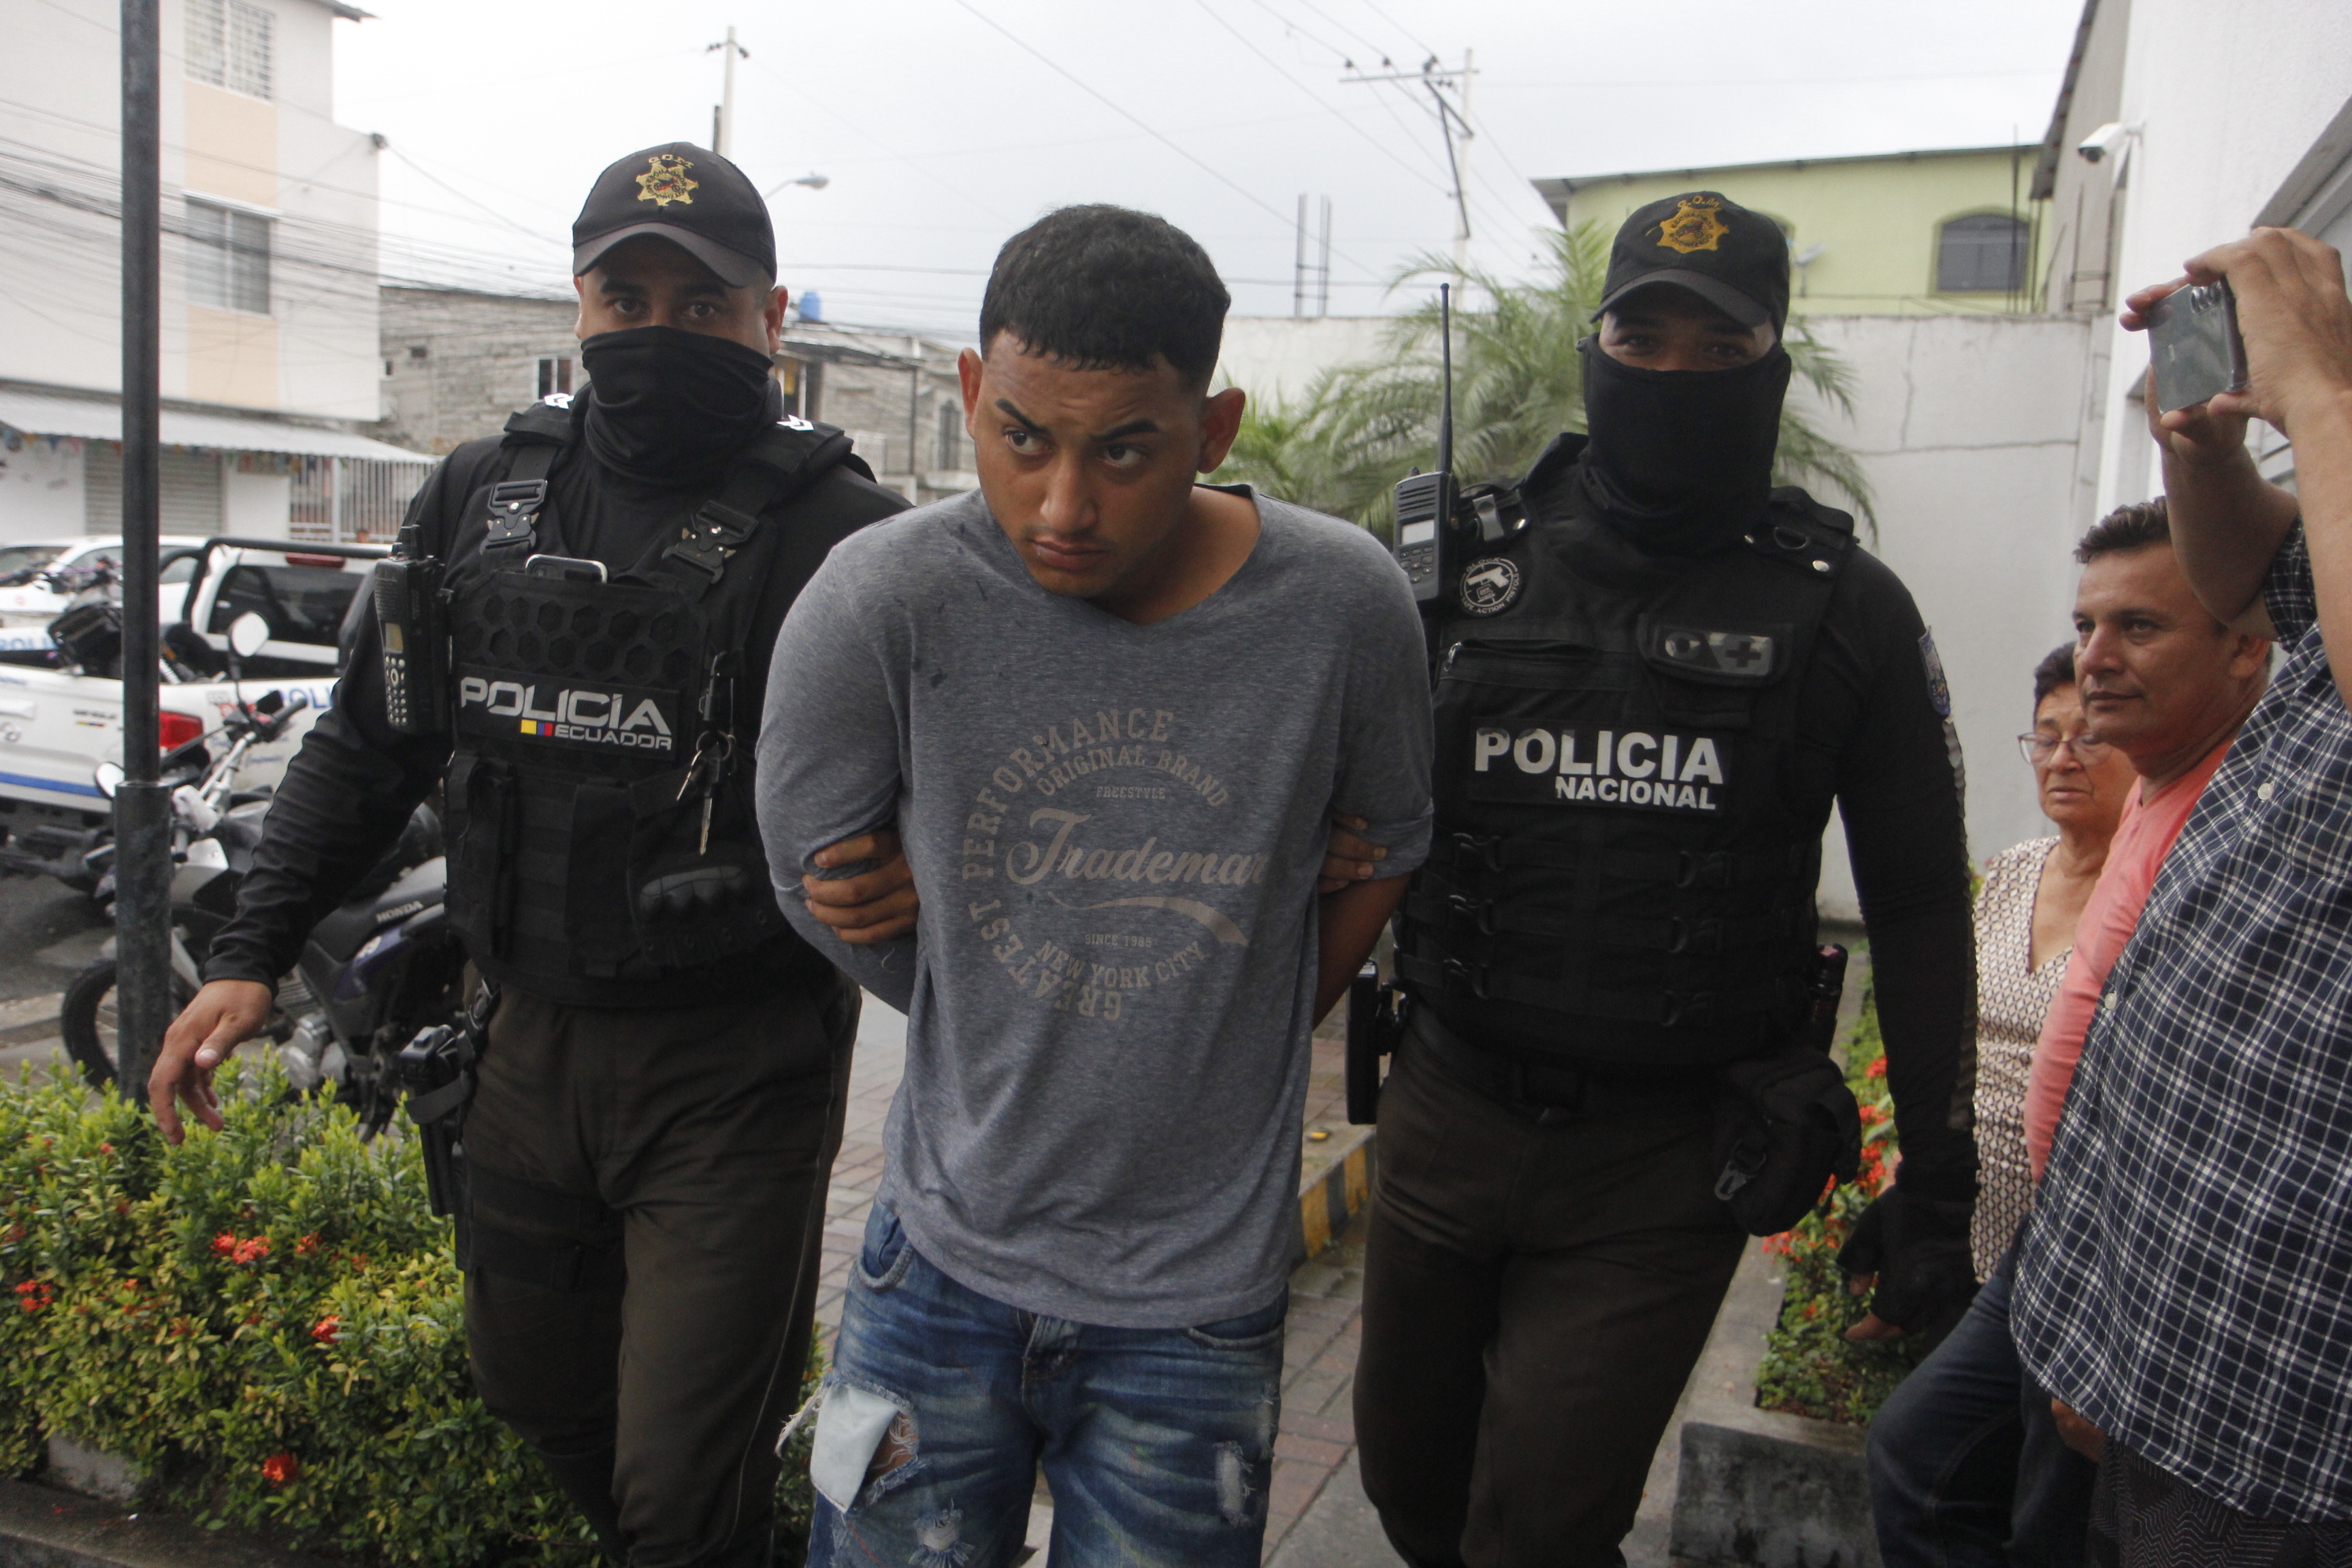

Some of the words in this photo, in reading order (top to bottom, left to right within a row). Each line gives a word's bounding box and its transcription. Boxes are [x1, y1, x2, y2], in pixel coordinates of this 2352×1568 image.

[1466, 557, 1501, 573] GLOCK
[1477, 602, 1505, 614] ACTION
[1505, 572, 1520, 602] PISTOLS
[554, 724, 672, 751] ECUADOR
[1474, 727, 1725, 785] POLICIA
[962, 708, 1173, 880] PERFORMANCE
[1035, 745, 1146, 796] ORIGINAL
[1157, 749, 1229, 807] BRAND
[1096, 785, 1166, 800] FREESTYLE
[1555, 775, 1716, 811] NACIONAL
[1006, 807, 1272, 885] Trademar
[376, 900, 423, 924] HONDA
[968, 898, 1122, 1020] GREATEST
[1085, 933, 1119, 946] SINCE
[1035, 939, 1088, 980] NEW
[1090, 963, 1152, 990] YORK
[1156, 939, 1207, 984] CITY
